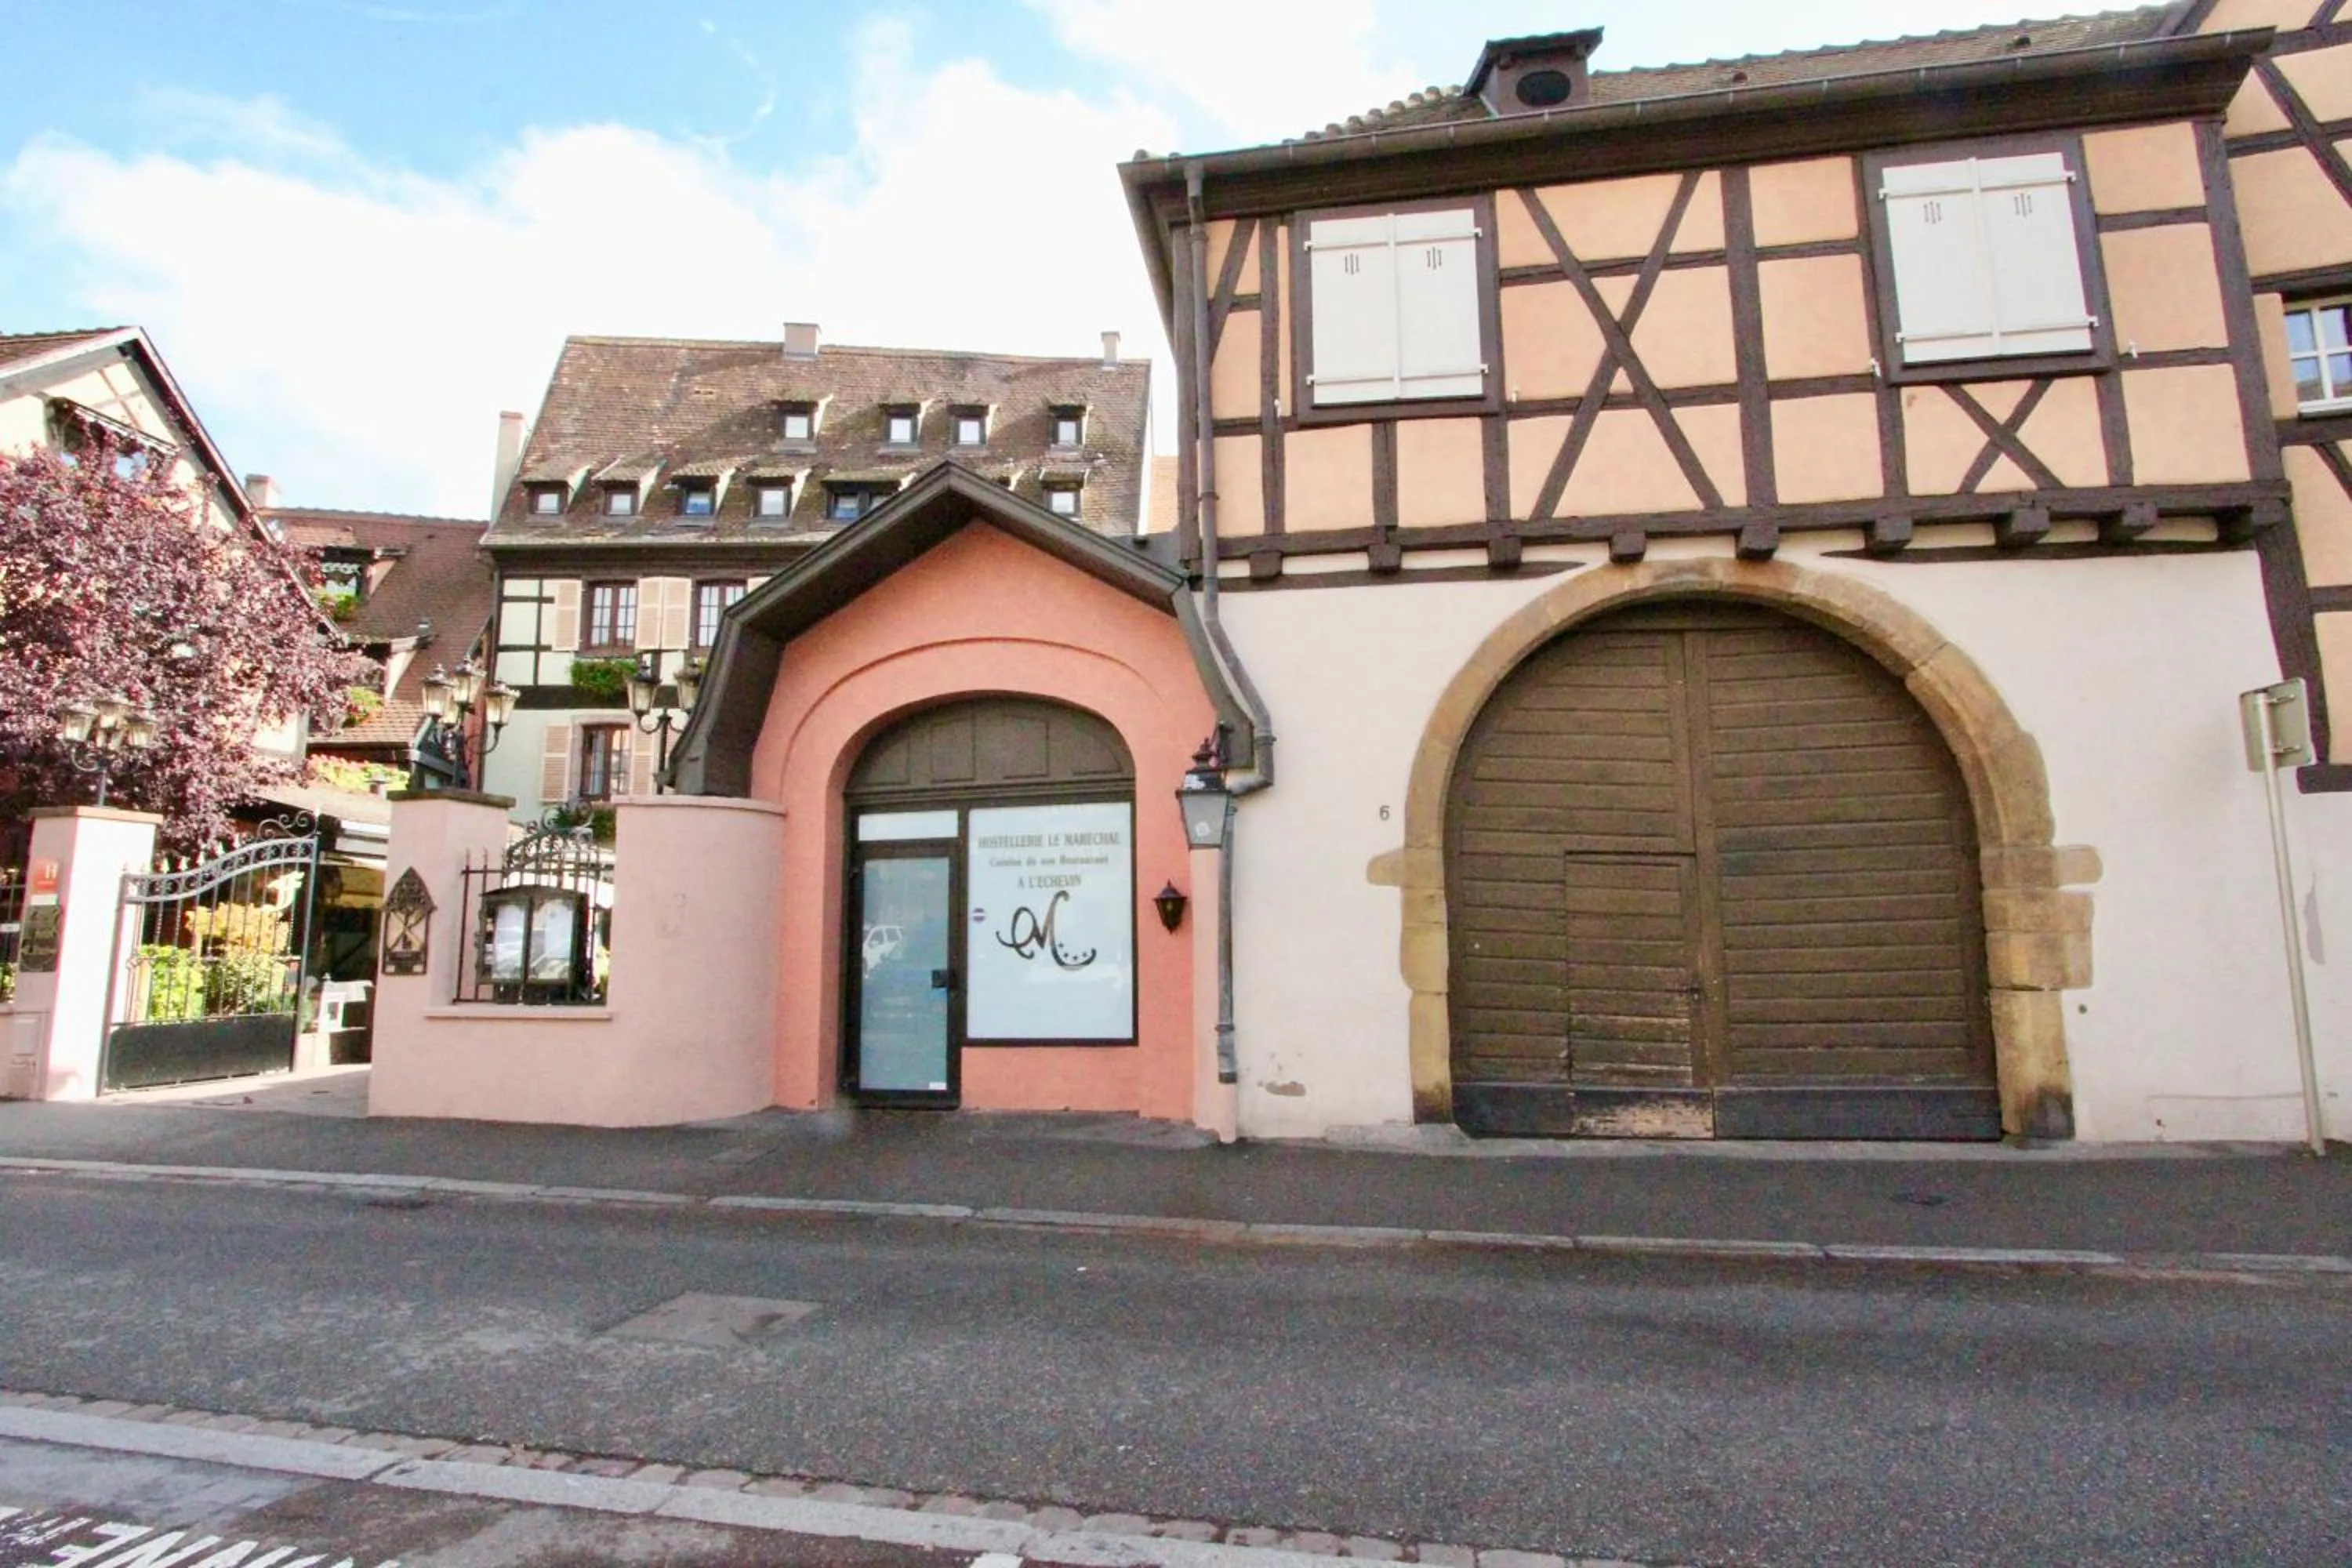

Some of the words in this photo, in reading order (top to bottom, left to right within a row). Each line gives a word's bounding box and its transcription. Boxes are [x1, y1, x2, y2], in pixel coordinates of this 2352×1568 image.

[1379, 804, 1390, 821] 6
[978, 834, 1044, 848] HOSTELLERIE
[1047, 833, 1060, 847] LE
